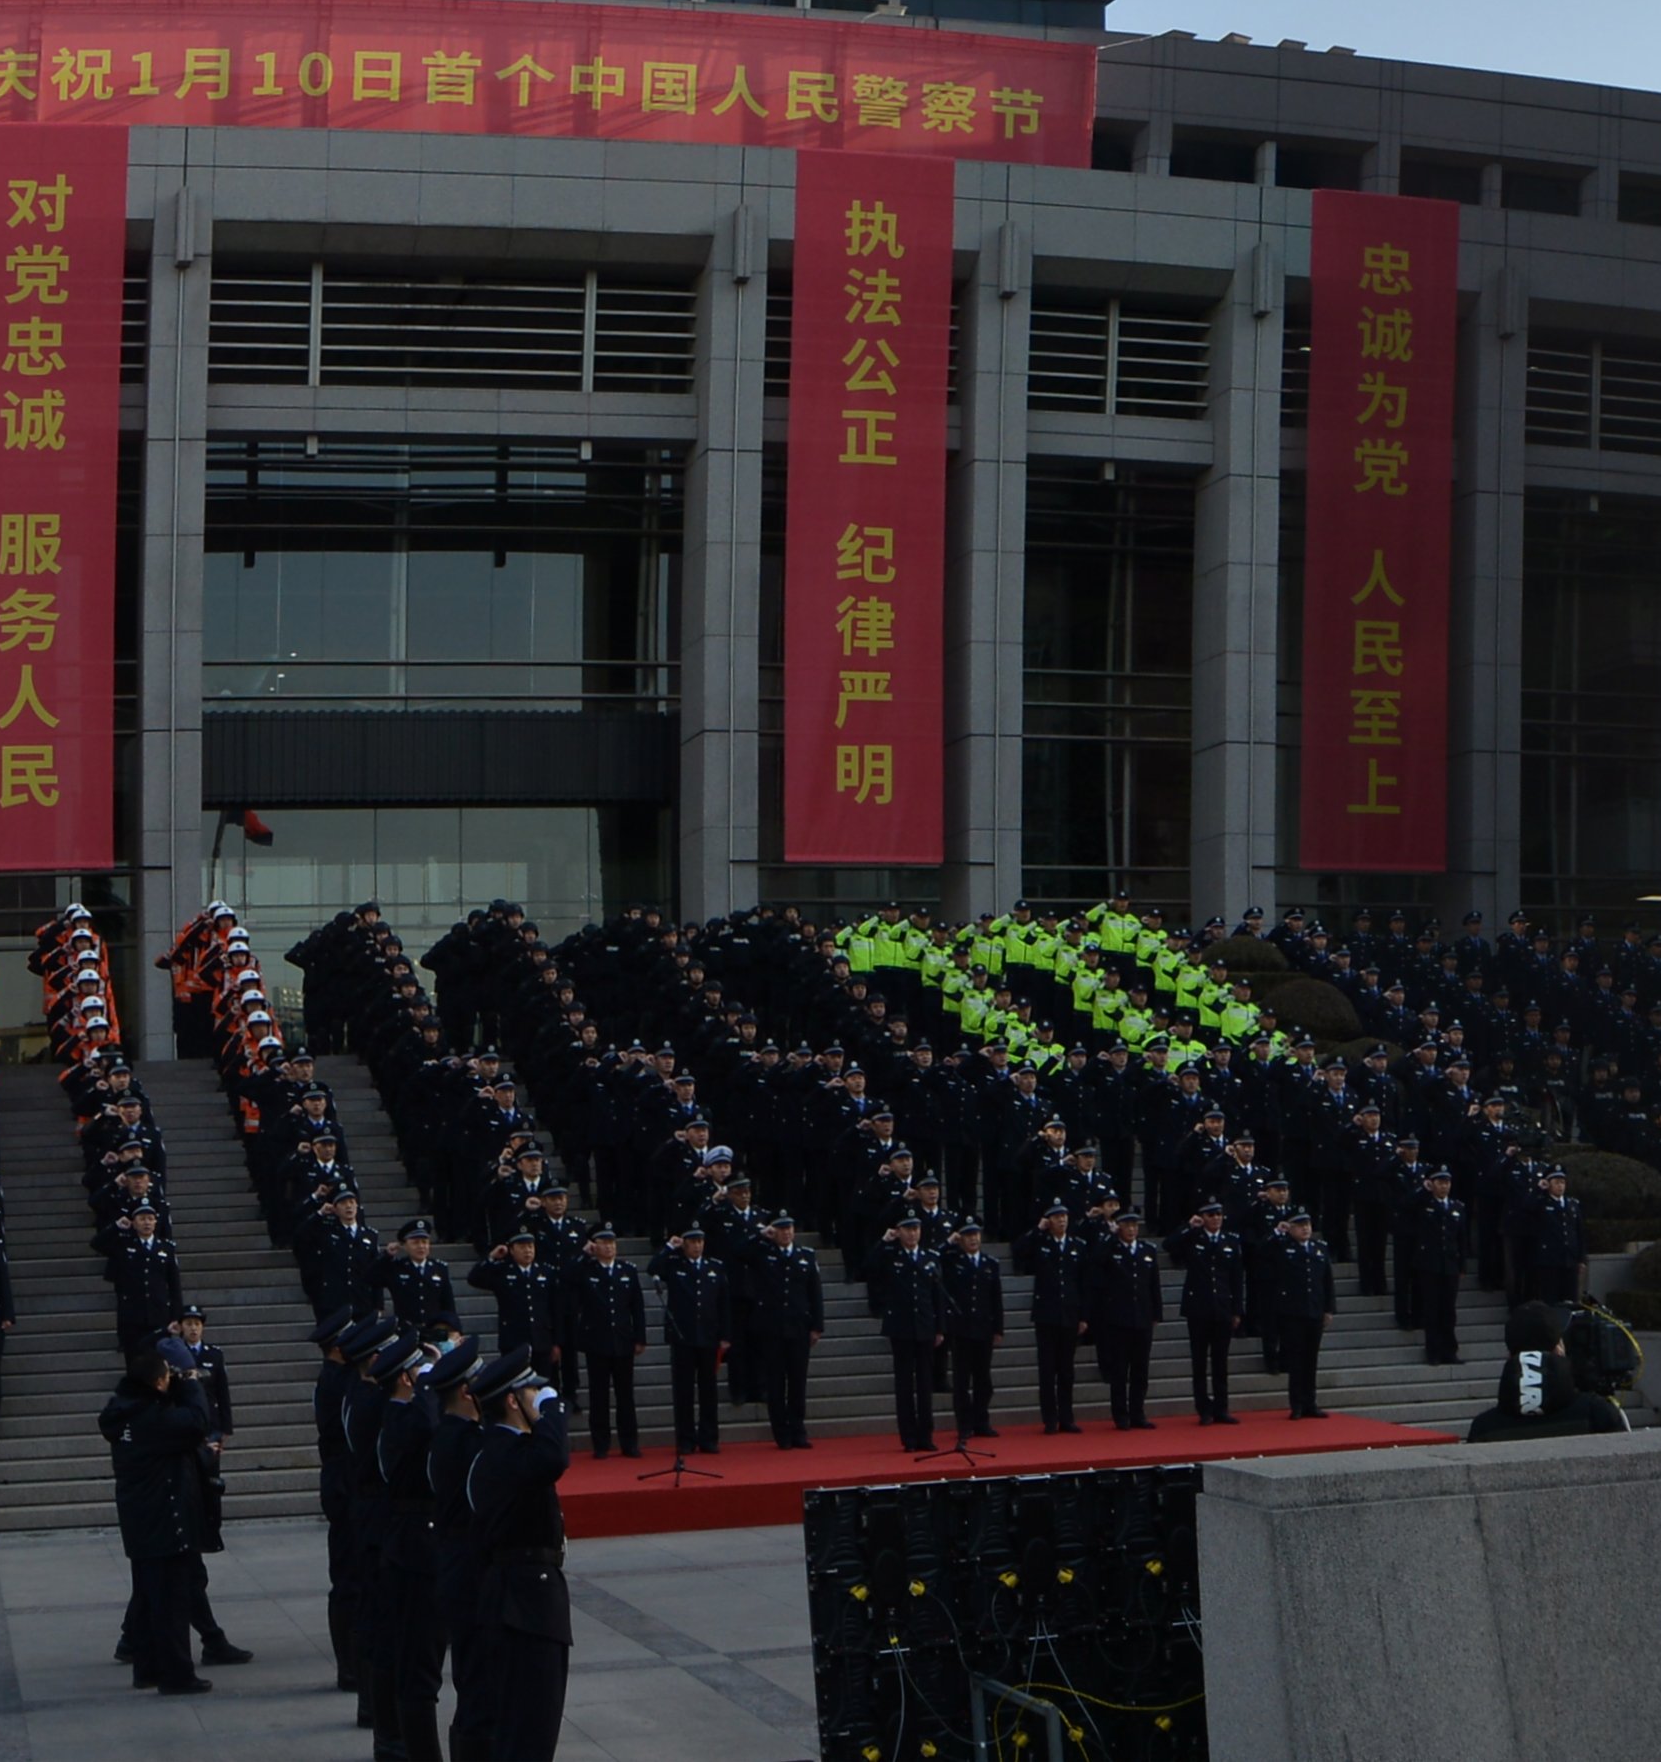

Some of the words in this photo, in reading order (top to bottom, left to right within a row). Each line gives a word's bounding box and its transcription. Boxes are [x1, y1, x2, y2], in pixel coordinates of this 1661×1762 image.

[0, 172, 75, 452] 对党忠诚
[839, 199, 906, 467] 执法公正
[1353, 242, 1414, 497] 忠诚为党
[834, 523, 898, 806] 纪律严明
[1346, 548, 1406, 816] 人民至上
